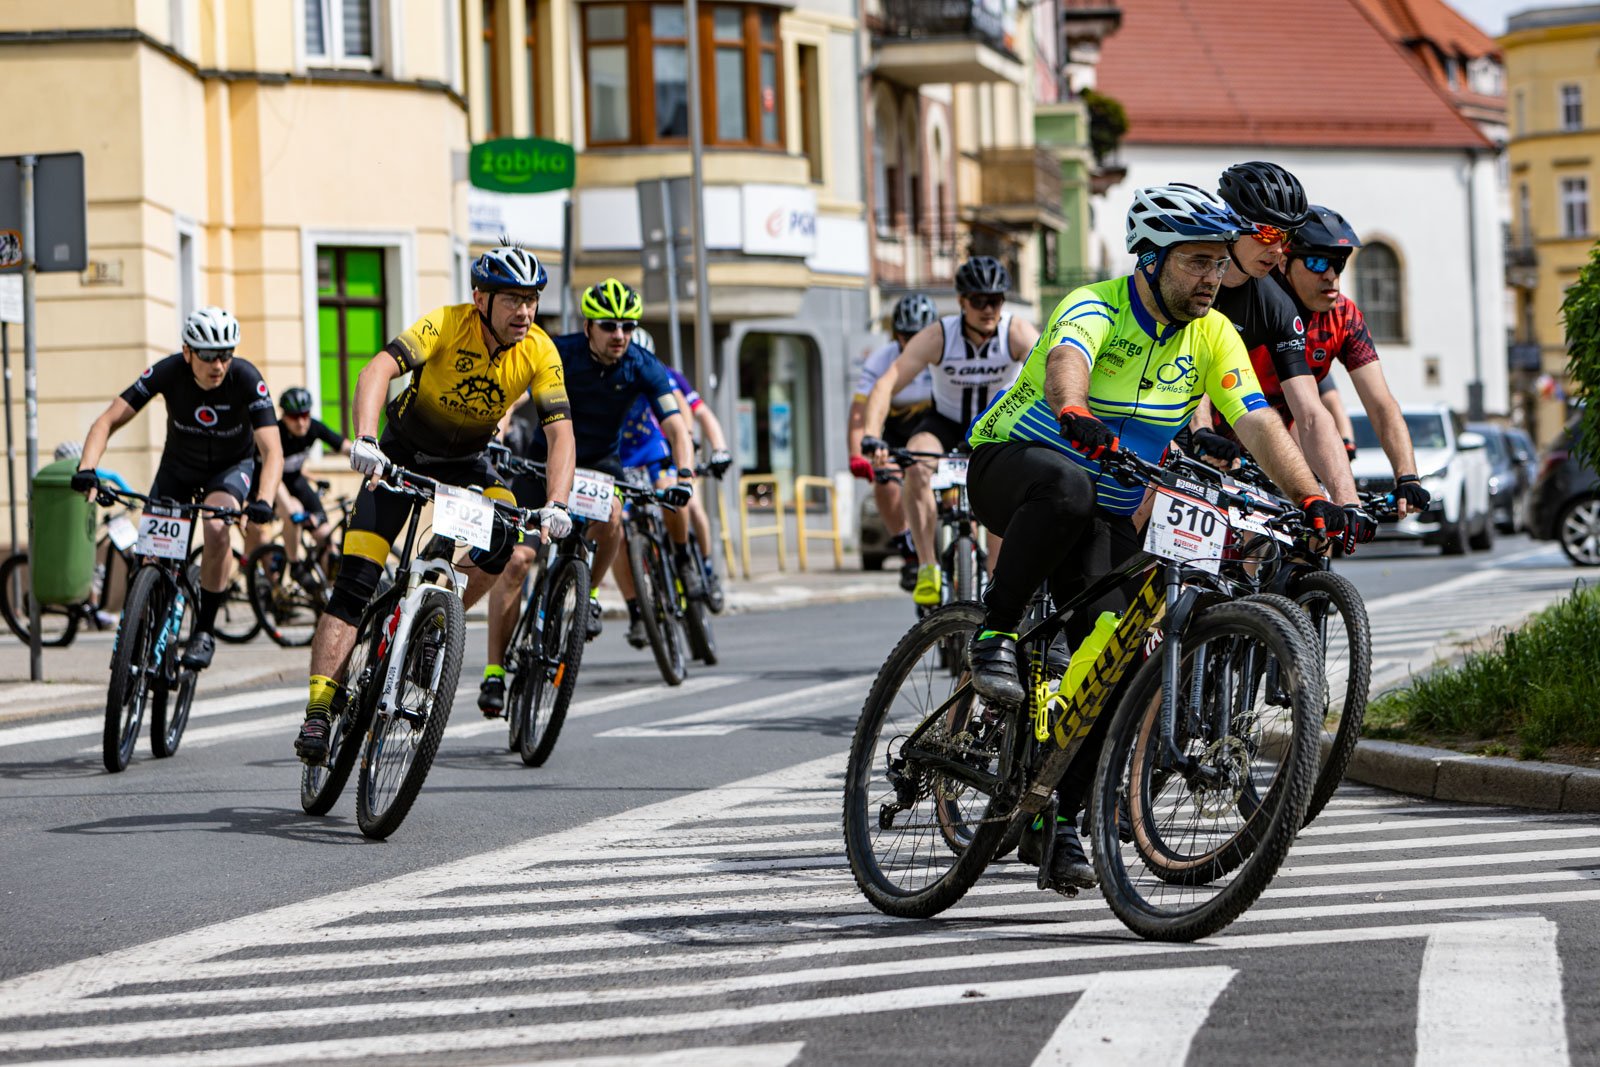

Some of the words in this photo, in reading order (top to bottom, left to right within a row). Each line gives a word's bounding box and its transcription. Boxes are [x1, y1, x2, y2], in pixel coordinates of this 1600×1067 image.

[481, 147, 566, 173] żabka
[959, 364, 1008, 376] GIANT
[577, 480, 610, 500] 235
[444, 500, 484, 526] 502
[1166, 498, 1216, 538] 510
[147, 519, 181, 538] 240
